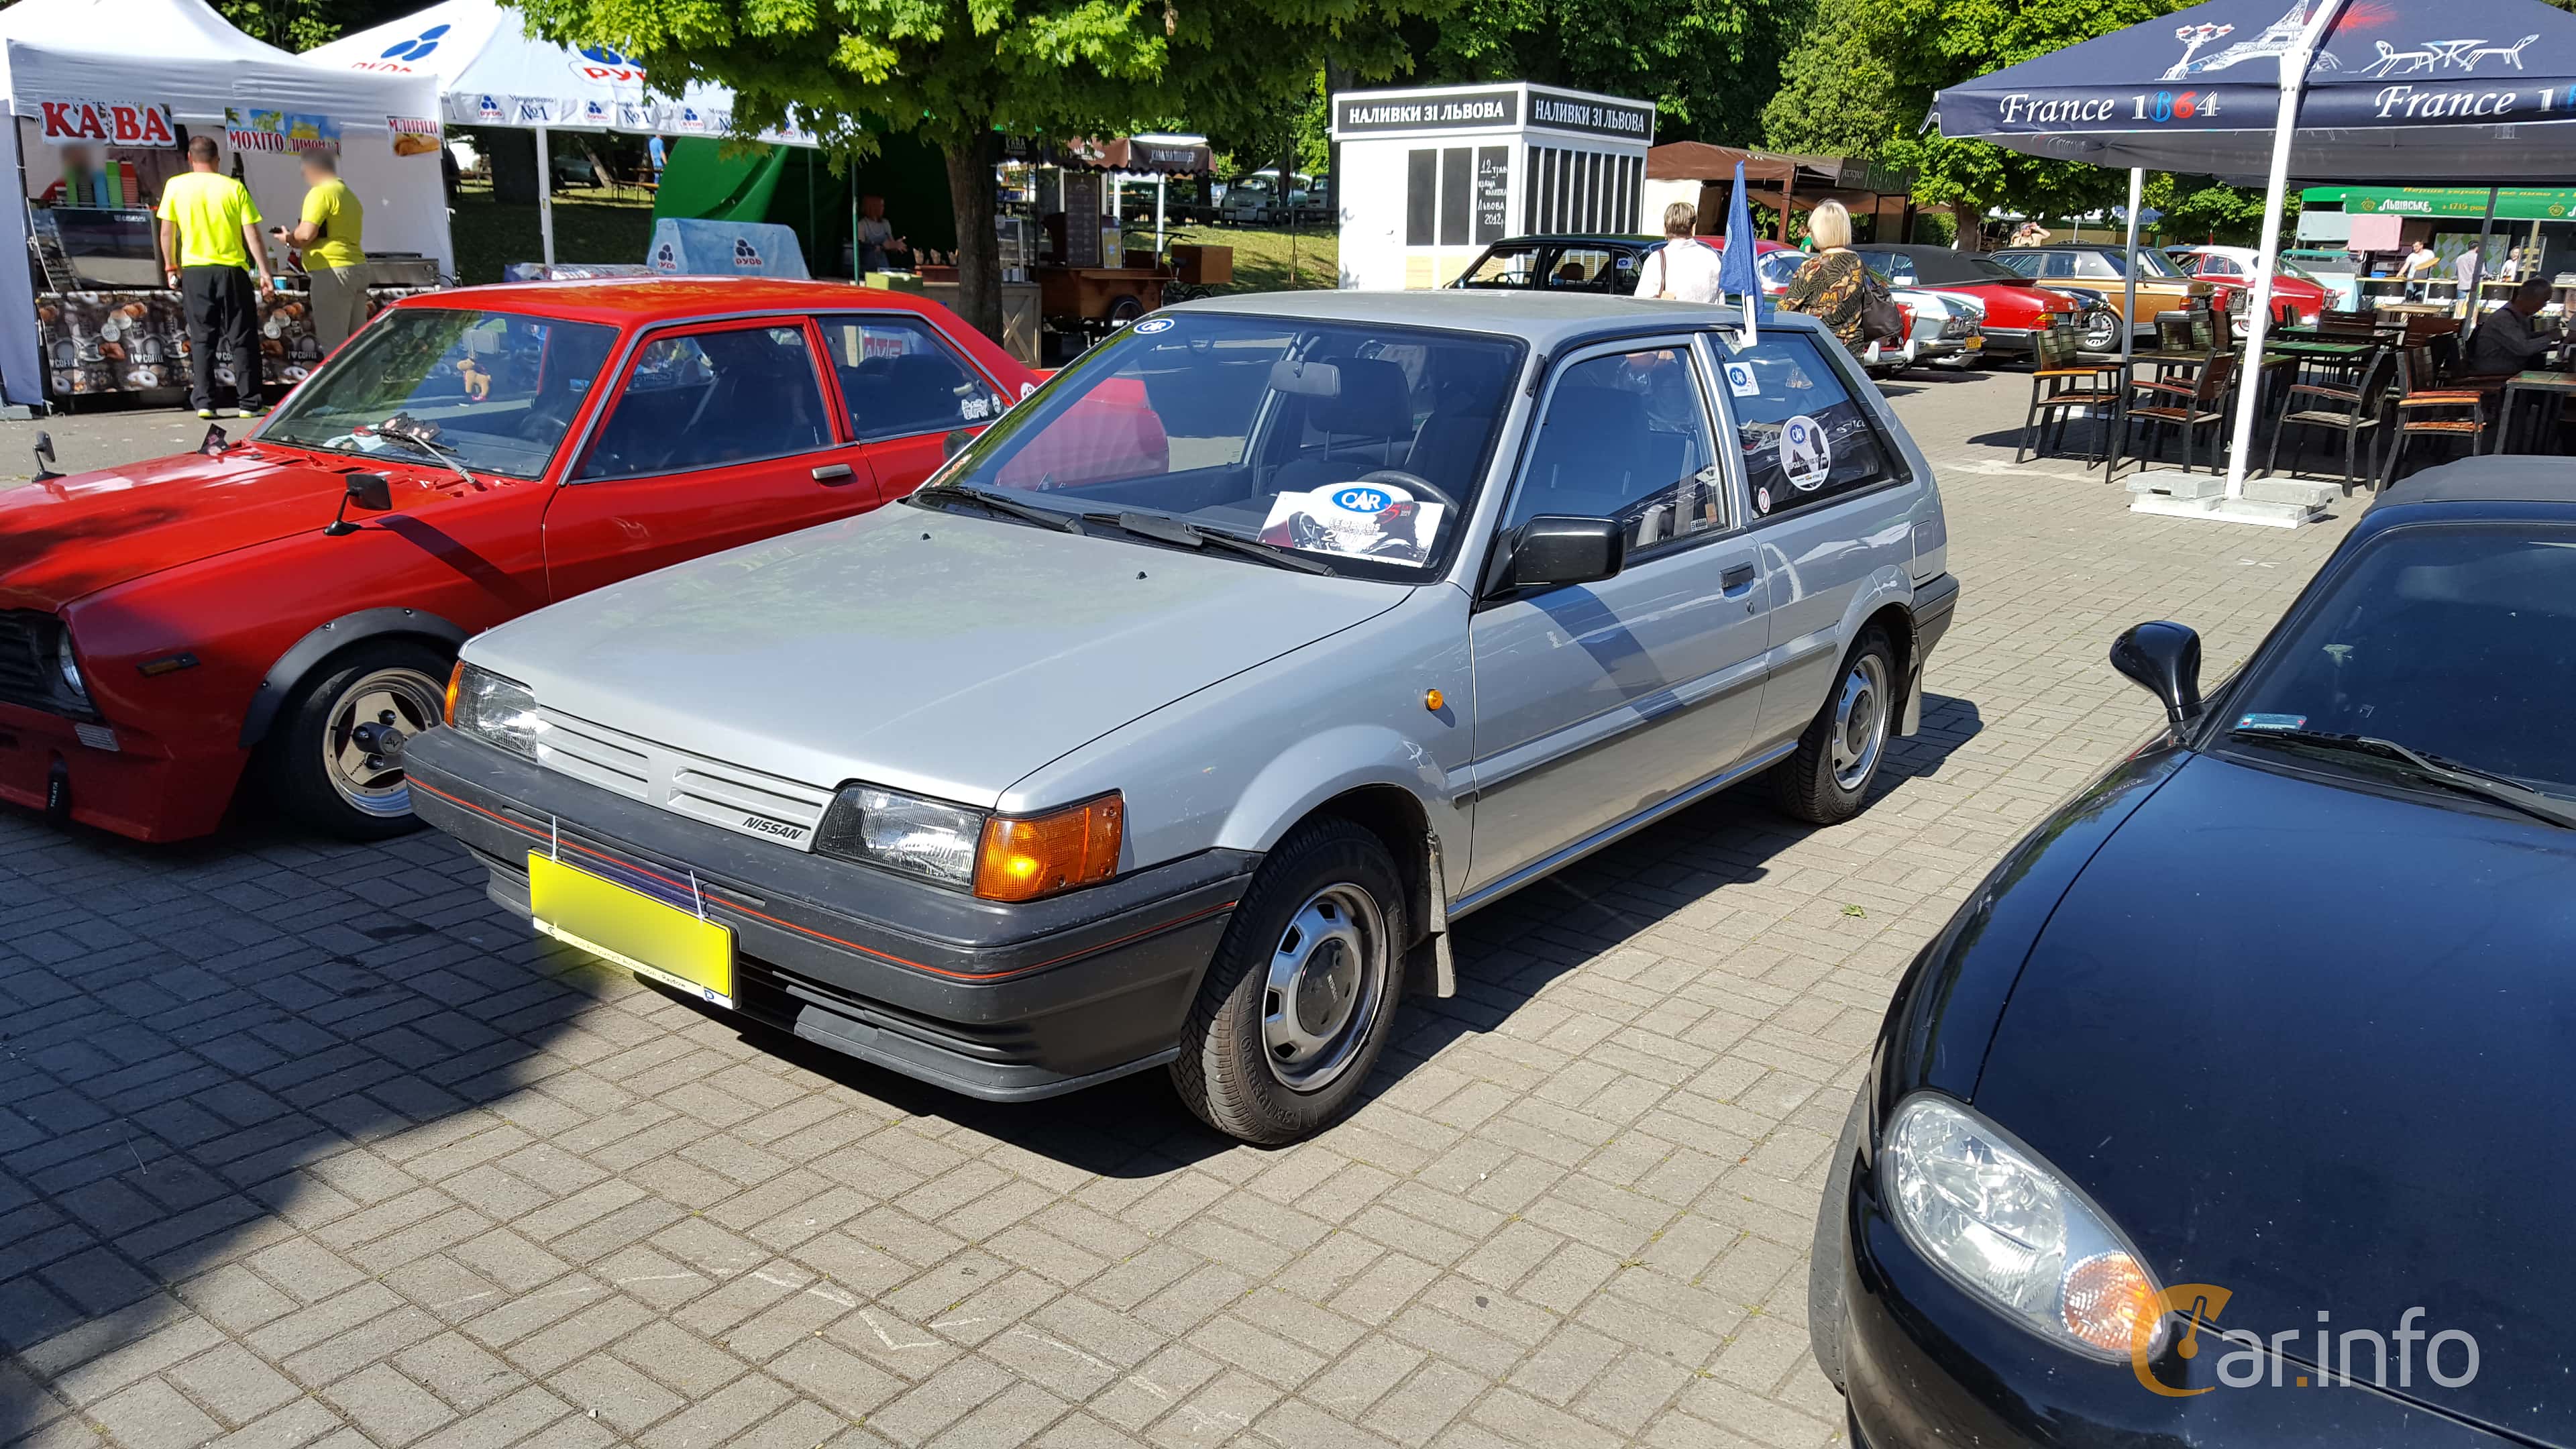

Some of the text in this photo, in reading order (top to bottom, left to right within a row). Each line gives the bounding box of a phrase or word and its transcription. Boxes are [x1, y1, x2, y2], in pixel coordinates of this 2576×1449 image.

[1349, 100, 1505, 124] НАЛИВКИ ЗІ ЛЬВОВА
[2000, 93, 2114, 123] France
[2374, 85, 2516, 119] France
[41, 102, 172, 142] КАВА
[1535, 99, 1644, 133] НАЛИВКИ ЗІ ЛЬВОВА
[229, 129, 284, 152] МОХІТО
[1341, 490, 1381, 511] CAR
[742, 816, 804, 840] NISSAN
